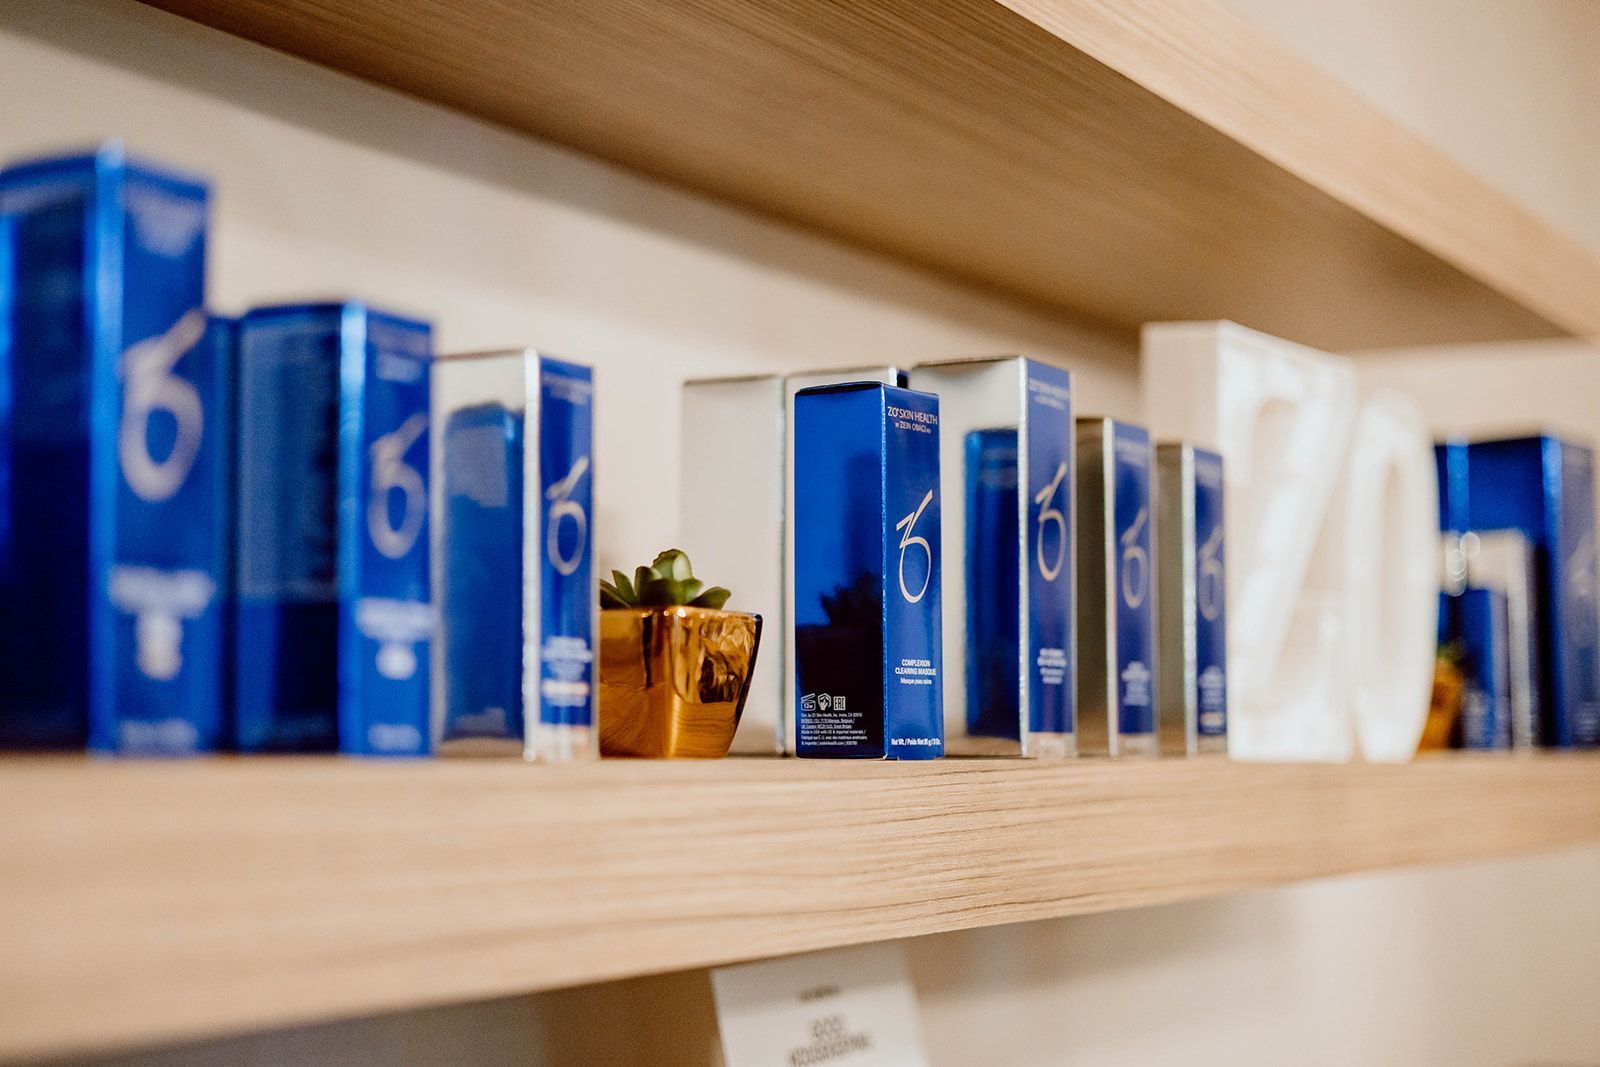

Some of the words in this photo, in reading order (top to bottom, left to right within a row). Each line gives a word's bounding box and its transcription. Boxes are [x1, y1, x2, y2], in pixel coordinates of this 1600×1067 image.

[899, 408, 914, 420] SKIN
[914, 411, 938, 425] HEALTH
[1215, 322, 1439, 762] ZO
[901, 659, 931, 667] COMPLEXION
[895, 667, 918, 675] CLEARING
[918, 668, 937, 676] MASQUE
